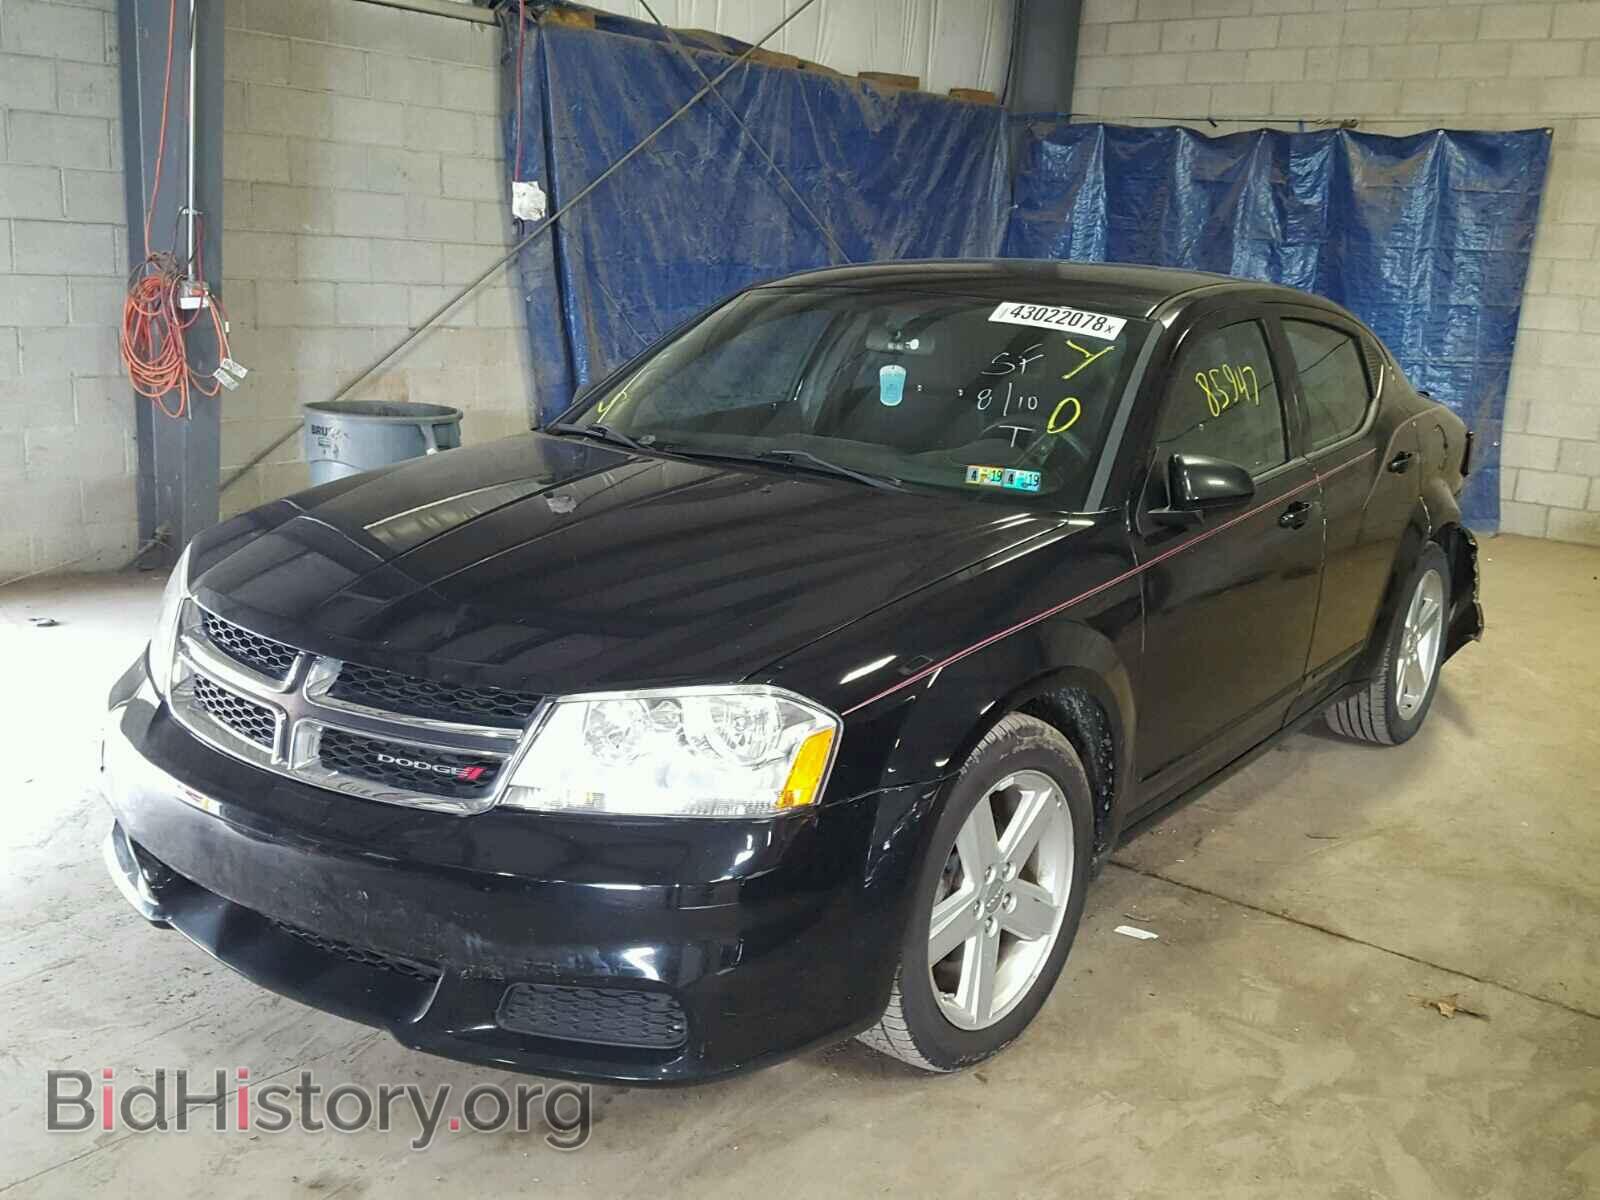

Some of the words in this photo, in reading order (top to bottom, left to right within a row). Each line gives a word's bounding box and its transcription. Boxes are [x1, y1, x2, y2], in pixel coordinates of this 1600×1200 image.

[971, 470, 977, 481] 4
[991, 470, 1002, 482] 19
[1008, 473, 1014, 485] 4
[1028, 474, 1040, 487] 19
[377, 754, 469, 776] DODGE
